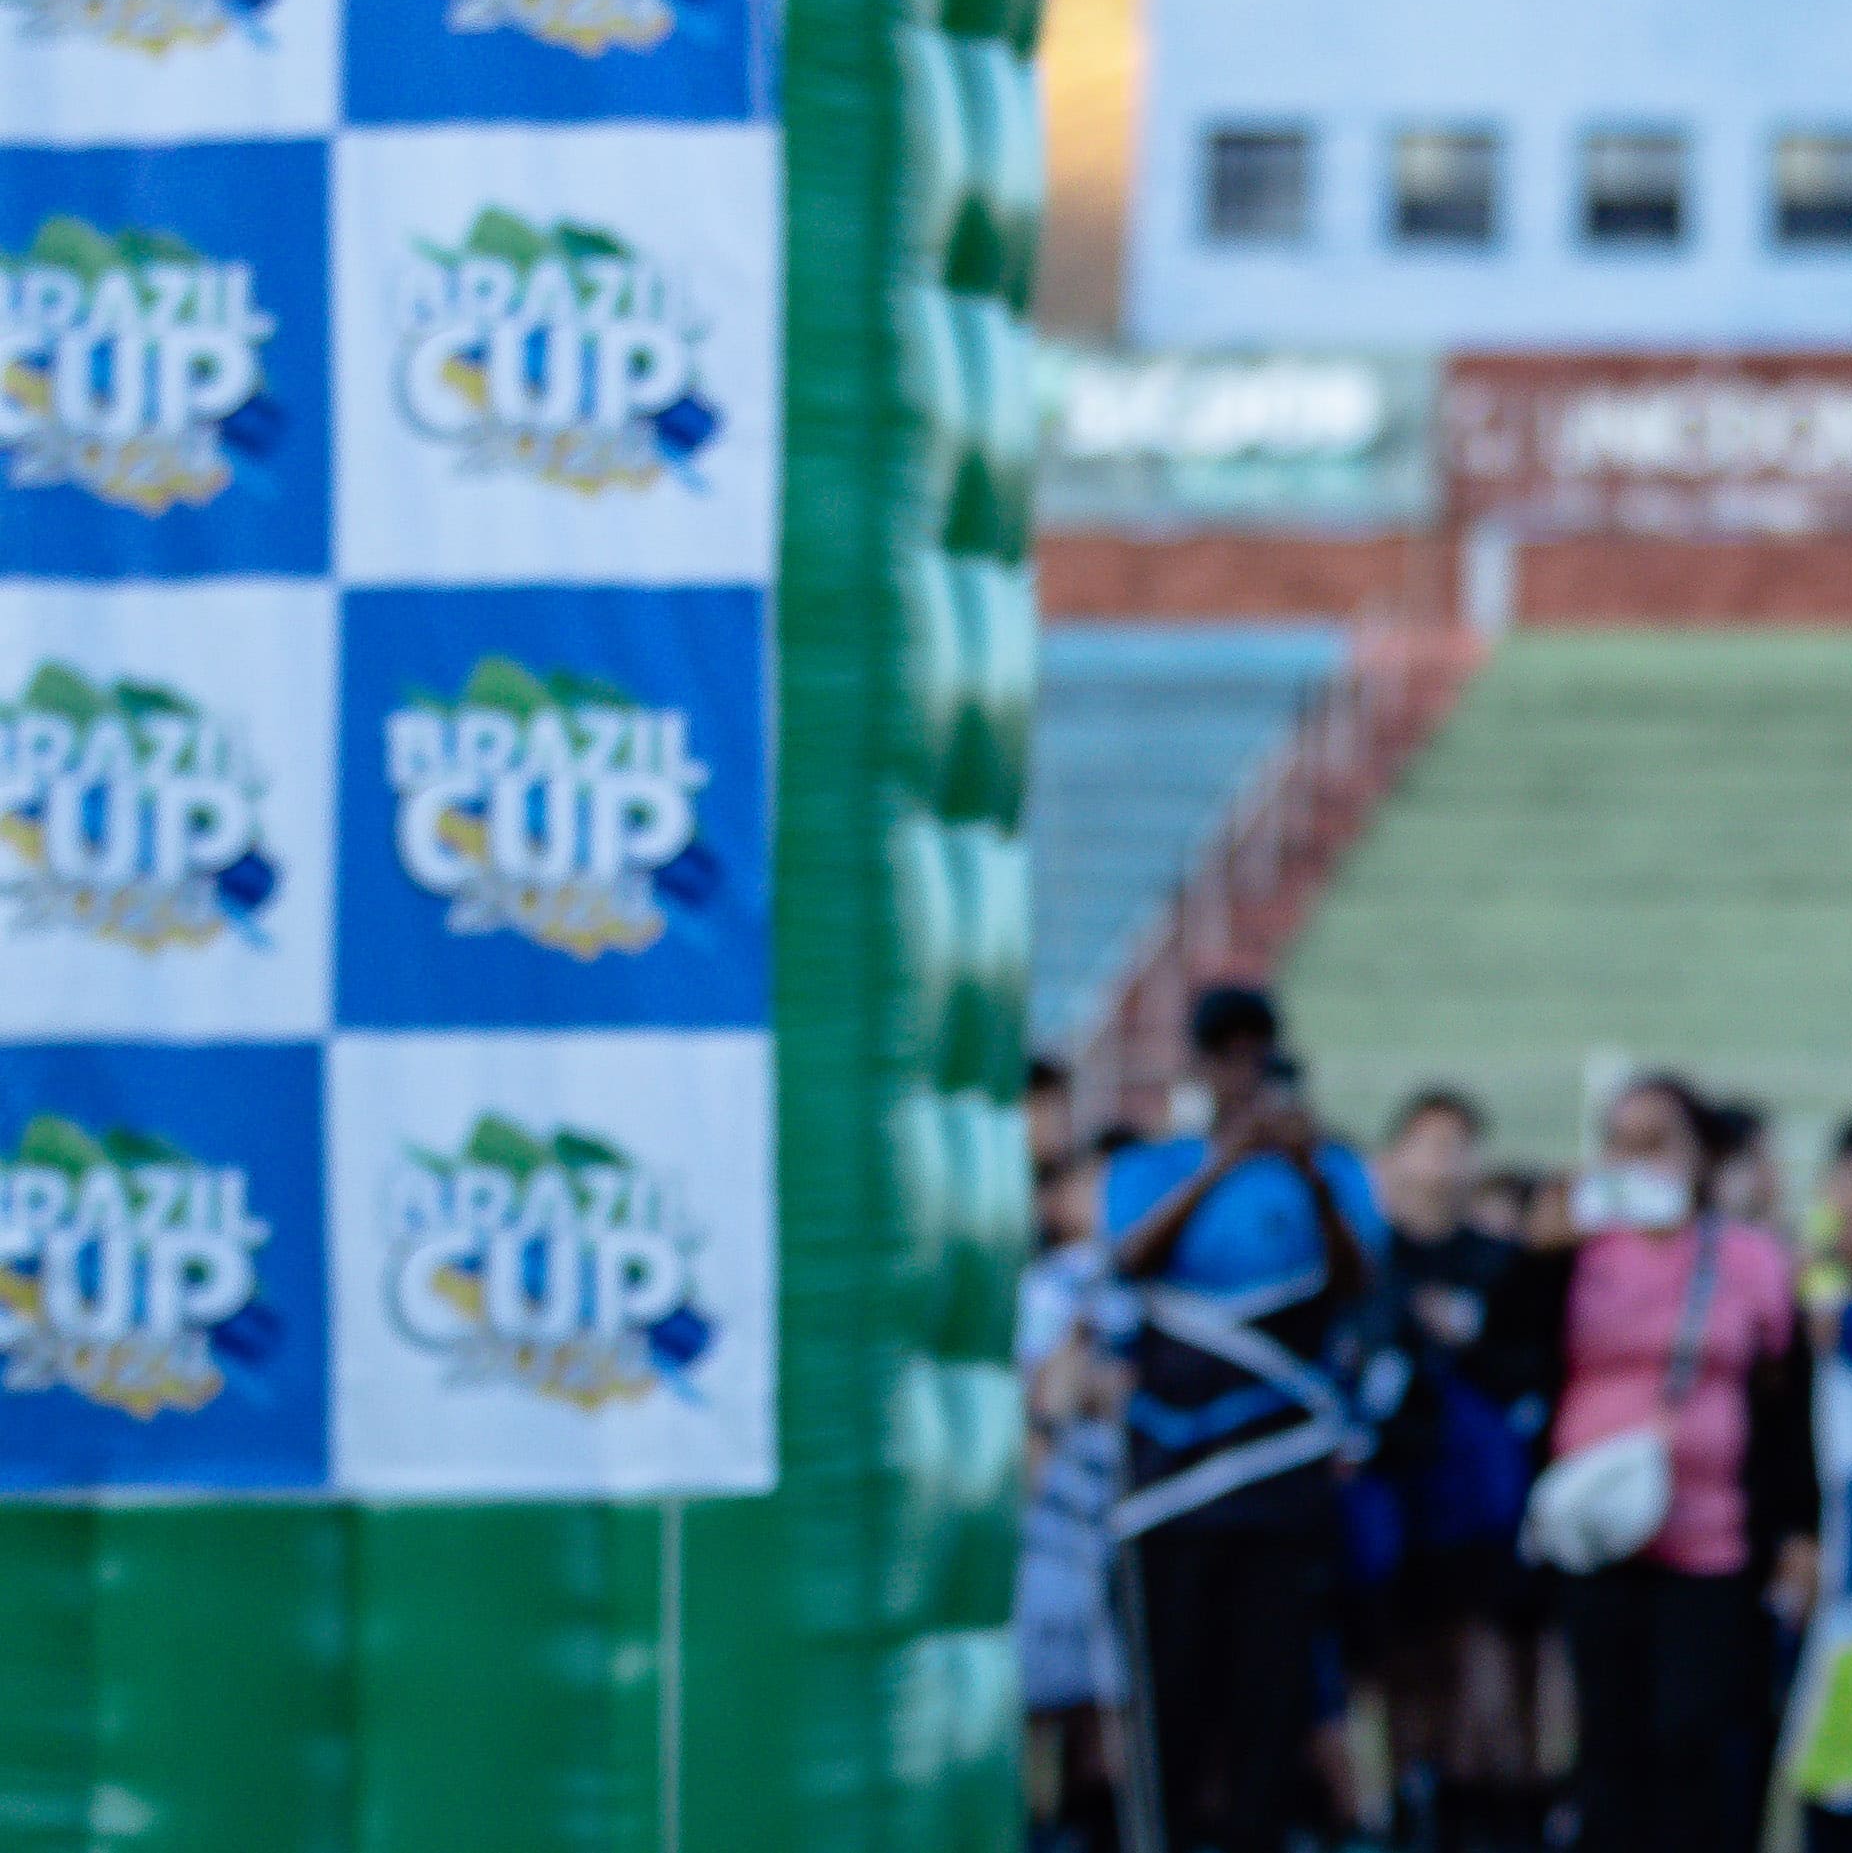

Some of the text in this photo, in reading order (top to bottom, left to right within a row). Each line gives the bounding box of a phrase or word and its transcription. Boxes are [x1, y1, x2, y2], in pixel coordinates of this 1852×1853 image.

[401, 327, 693, 443] CUP
[385, 709, 712, 790] BRAZIL
[399, 777, 696, 893] CUP
[394, 1231, 682, 1347] CUP
